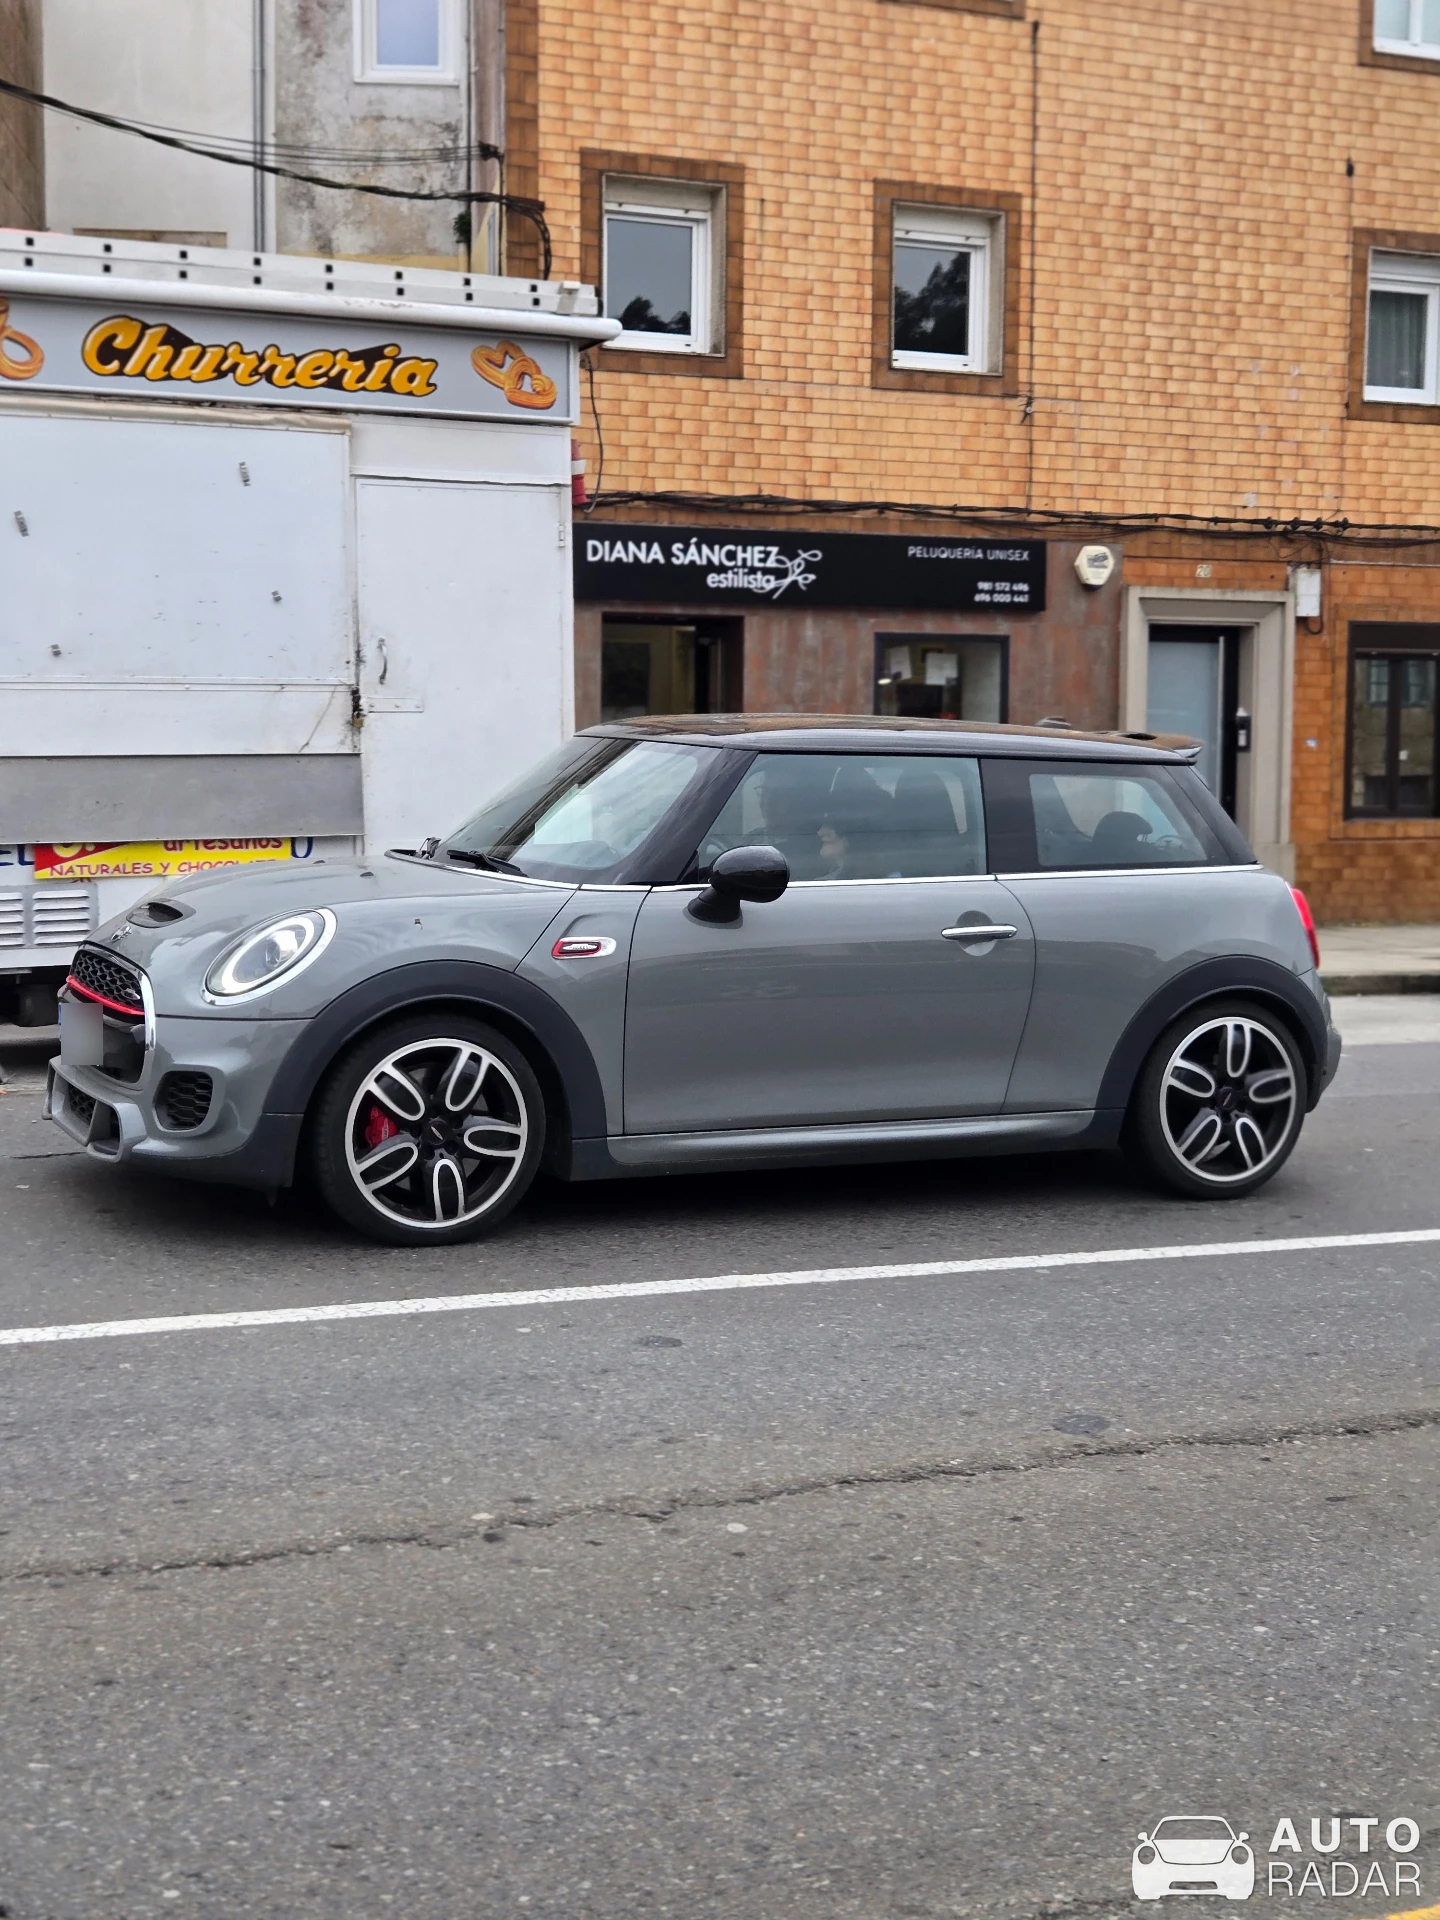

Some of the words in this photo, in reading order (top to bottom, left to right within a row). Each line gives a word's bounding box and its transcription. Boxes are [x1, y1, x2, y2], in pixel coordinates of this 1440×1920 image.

[82, 315, 438, 397] Churreria
[586, 539, 665, 564] DIANA
[671, 537, 779, 568] SÁNCHEZ
[907, 545, 983, 559] PELUQUERÍA
[986, 549, 1029, 561] UNISEX
[706, 568, 775, 589] estilista
[50, 862, 152, 876] NATURALES
[160, 862, 170, 873] Y
